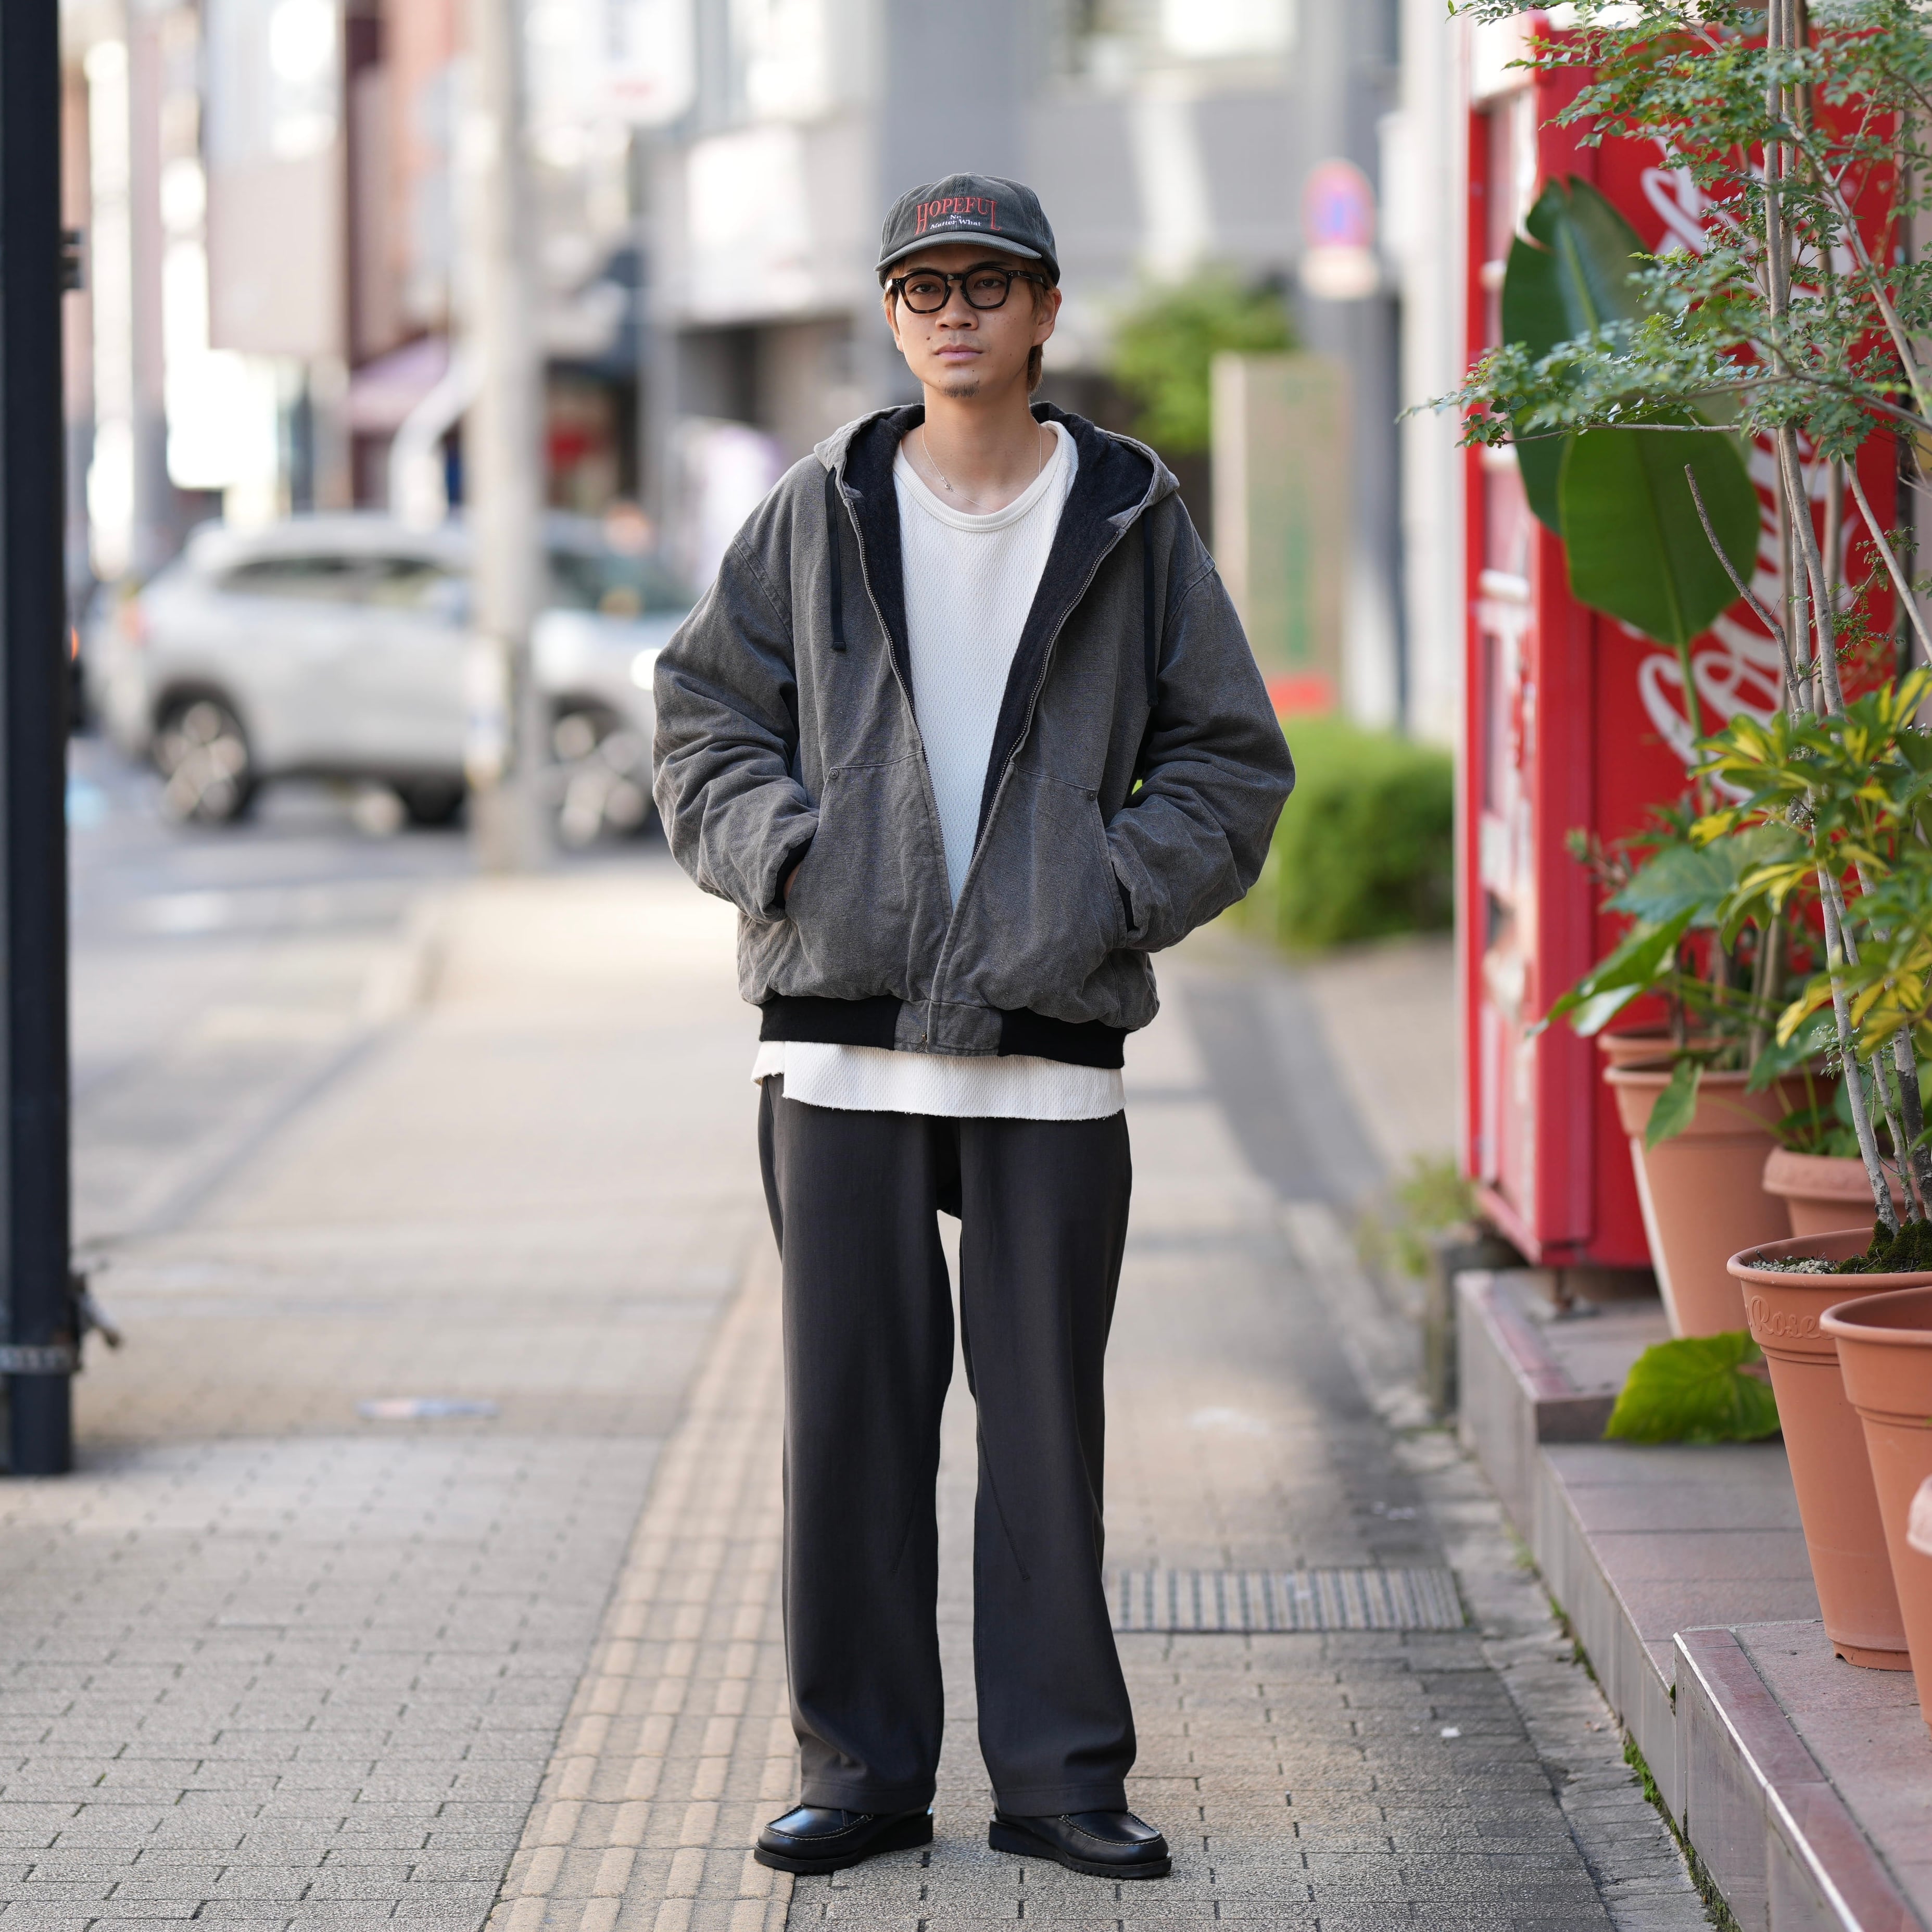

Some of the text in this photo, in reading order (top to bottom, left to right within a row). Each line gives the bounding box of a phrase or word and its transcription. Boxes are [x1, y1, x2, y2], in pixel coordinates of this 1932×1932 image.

[914, 196, 1002, 235] HOPEFUL
[930, 220, 957, 229] Matter
[1751, 1295, 1836, 1340] Rose
